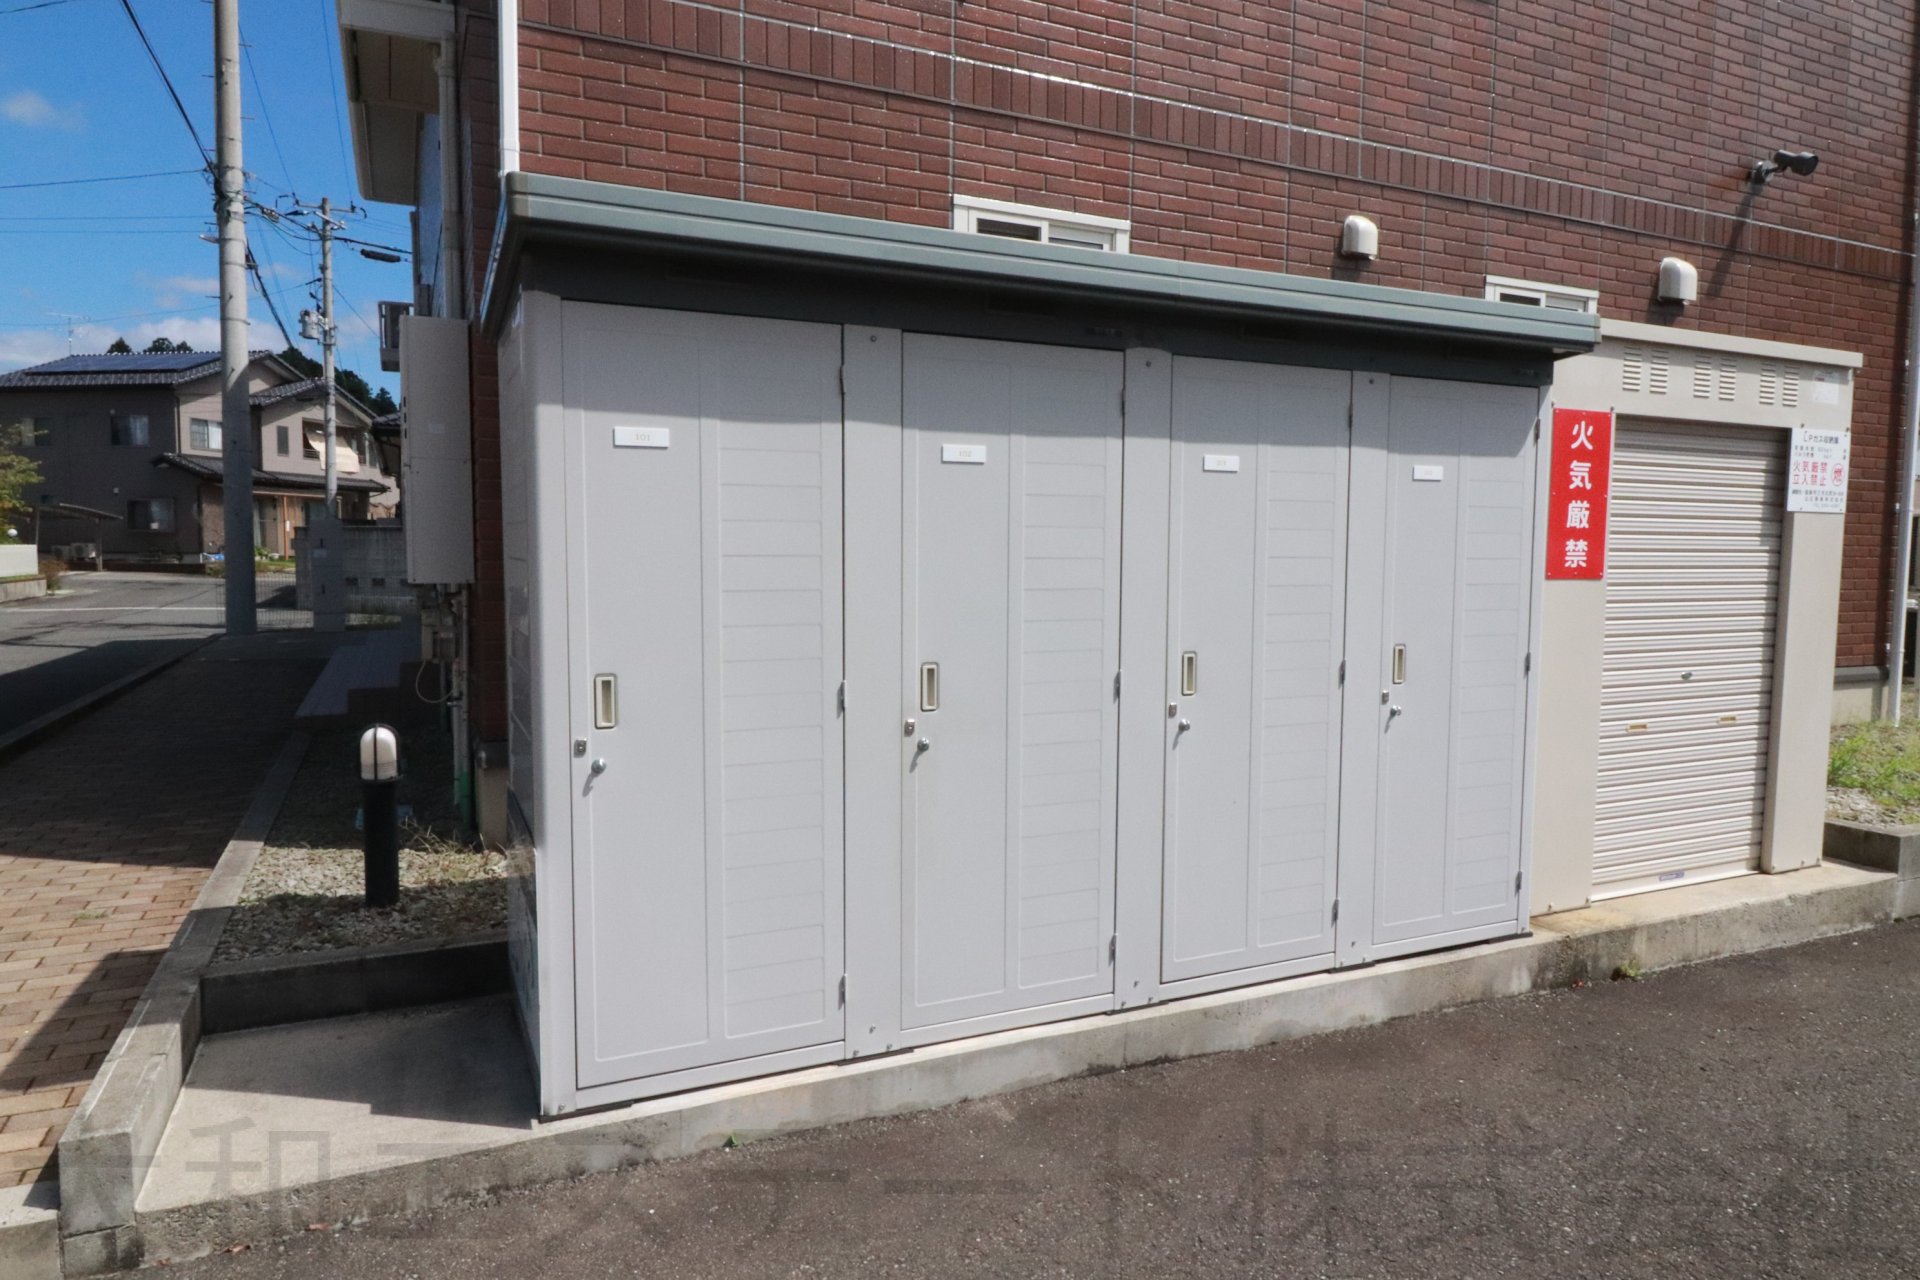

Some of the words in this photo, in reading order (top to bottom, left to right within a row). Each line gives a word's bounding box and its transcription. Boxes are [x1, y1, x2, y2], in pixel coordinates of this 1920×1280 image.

[1793, 461, 1828, 473] 火気厳禁
[1792, 474, 1826, 486] 立入禁止
[1564, 420, 1594, 568] 火気厳禁
